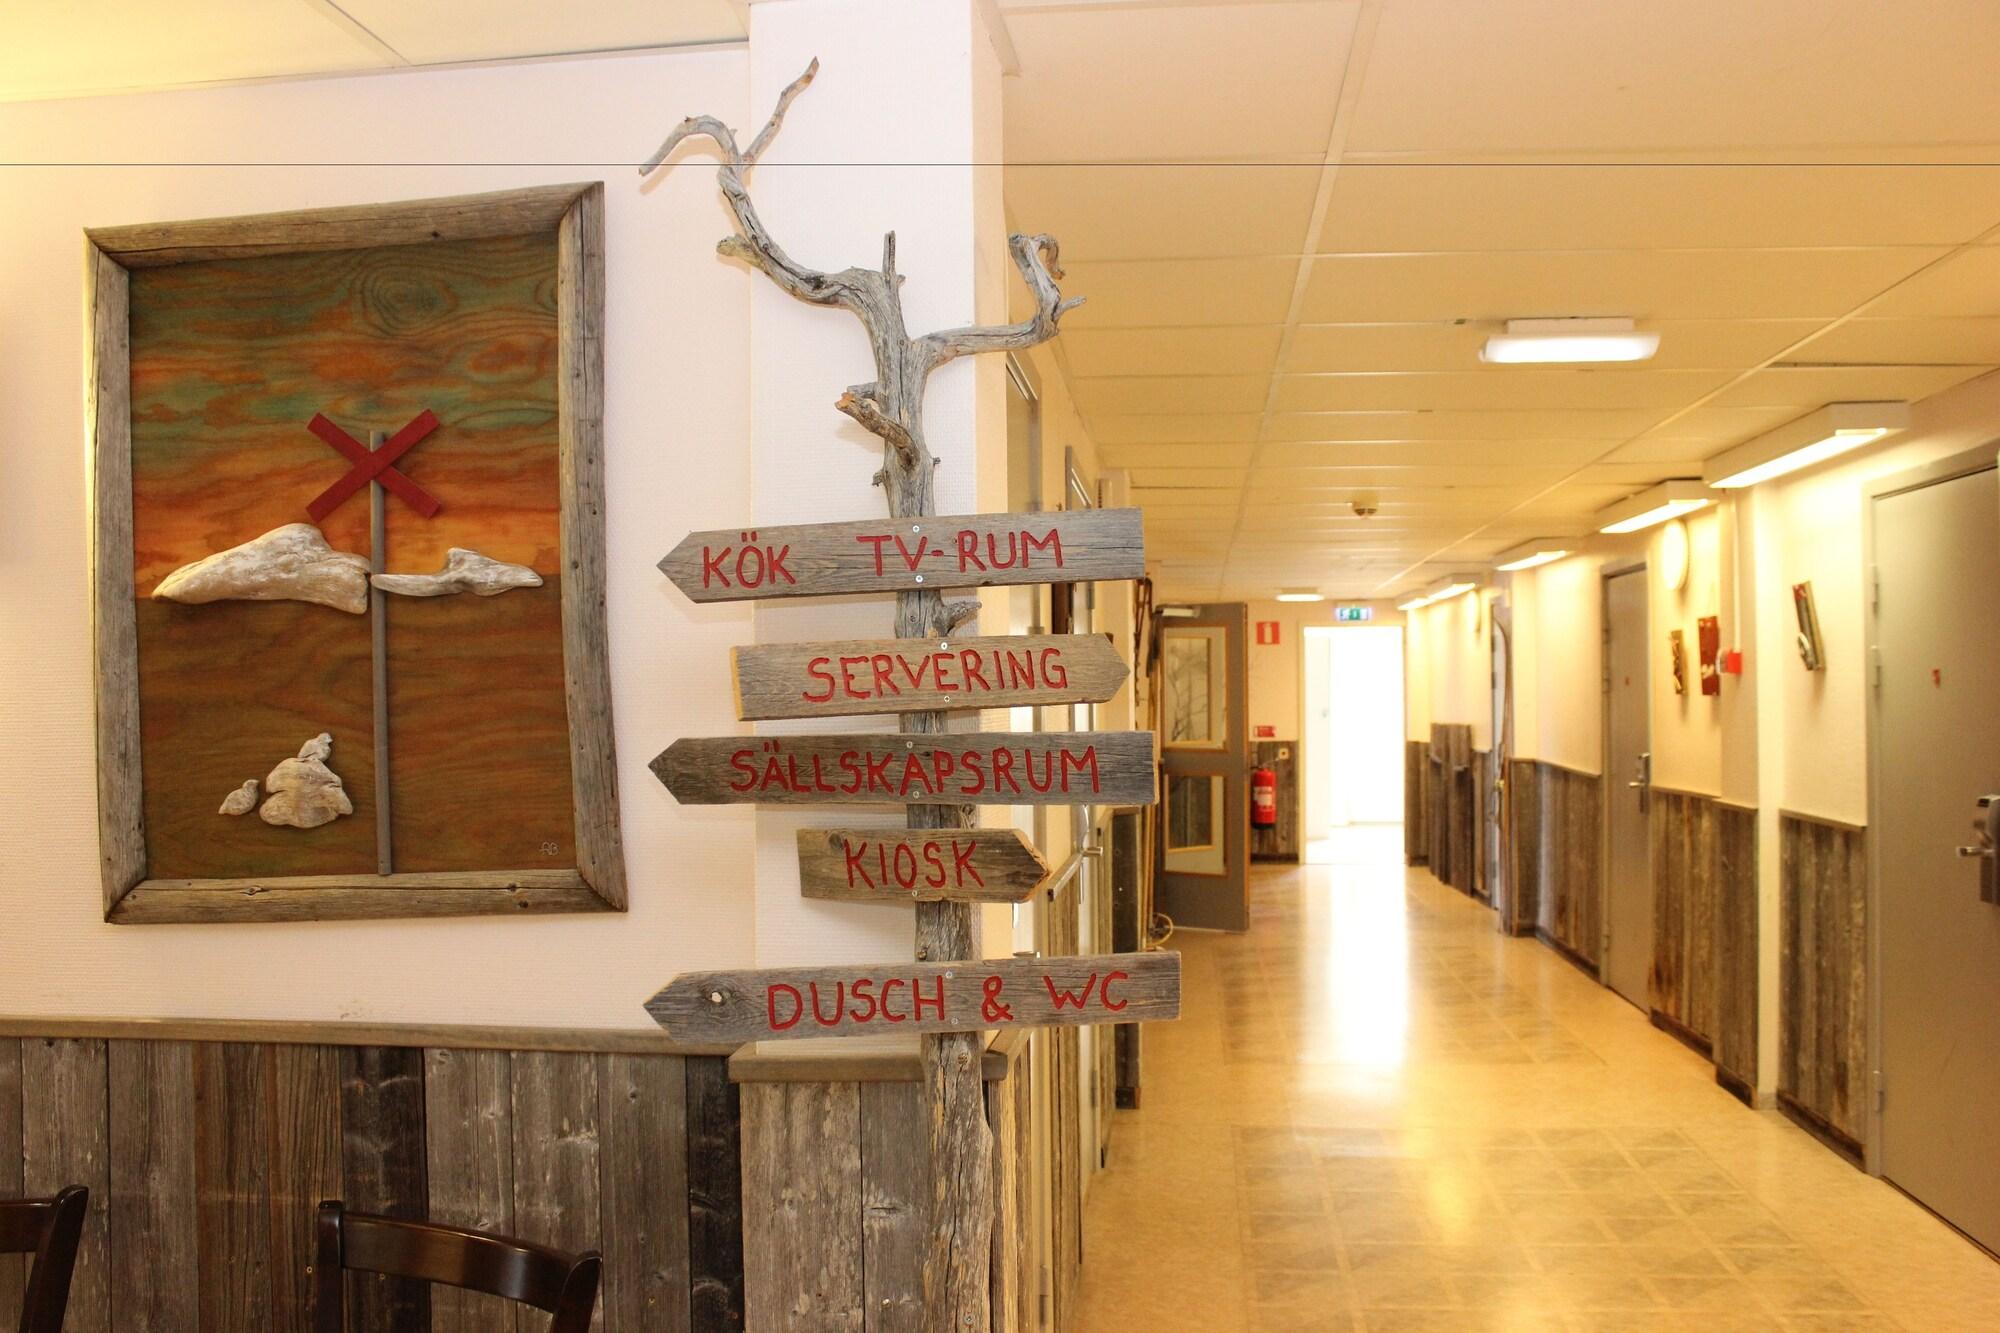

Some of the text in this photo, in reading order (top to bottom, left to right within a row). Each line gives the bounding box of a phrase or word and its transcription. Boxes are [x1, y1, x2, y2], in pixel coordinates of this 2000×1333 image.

[702, 529, 1064, 589] KÖK TV-RUM
[802, 647, 1067, 703] SERVERING
[730, 740, 1101, 796] SÄLLSKAPSRUM
[843, 839, 985, 890] KIOSK
[767, 971, 1129, 1031] DUSCH & WC
